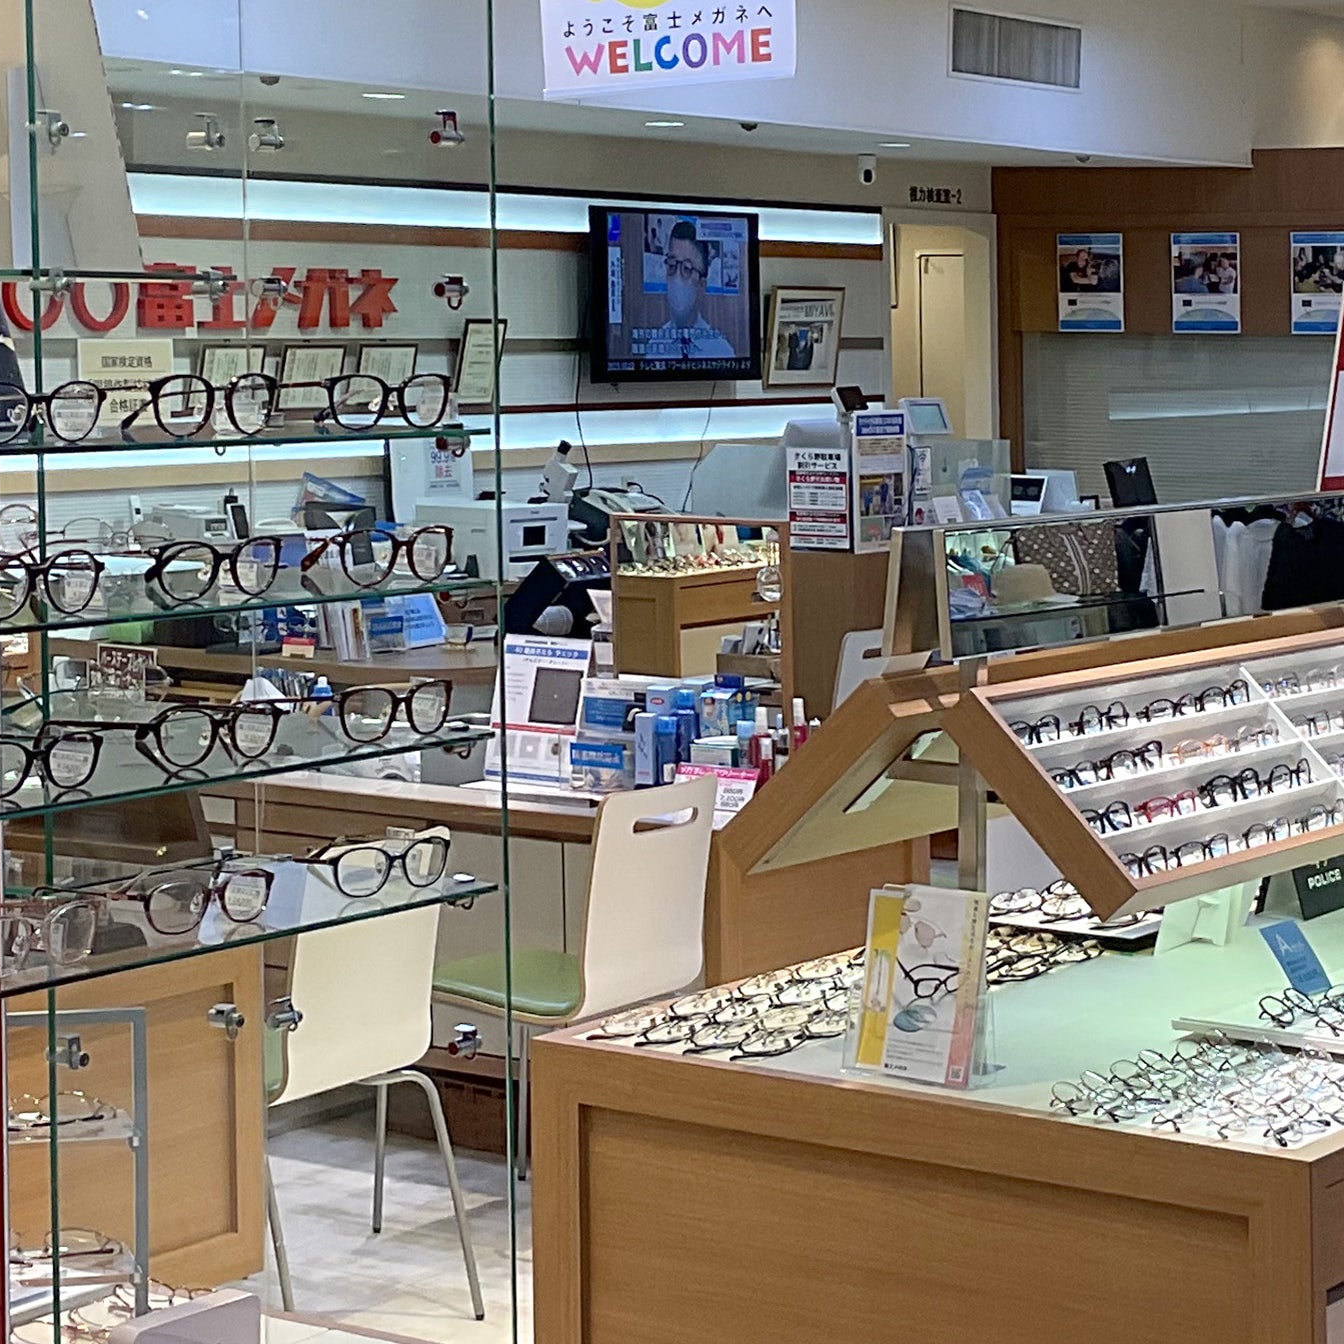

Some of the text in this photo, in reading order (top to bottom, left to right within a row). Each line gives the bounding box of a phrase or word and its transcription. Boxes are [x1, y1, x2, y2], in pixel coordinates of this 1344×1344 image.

[563, 5, 773, 38] ようこそ富士メガネへ
[565, 27, 773, 77] WELCOME
[137, 262, 400, 330] 富士メガネ
[1307, 869, 1343, 890] POLICE
